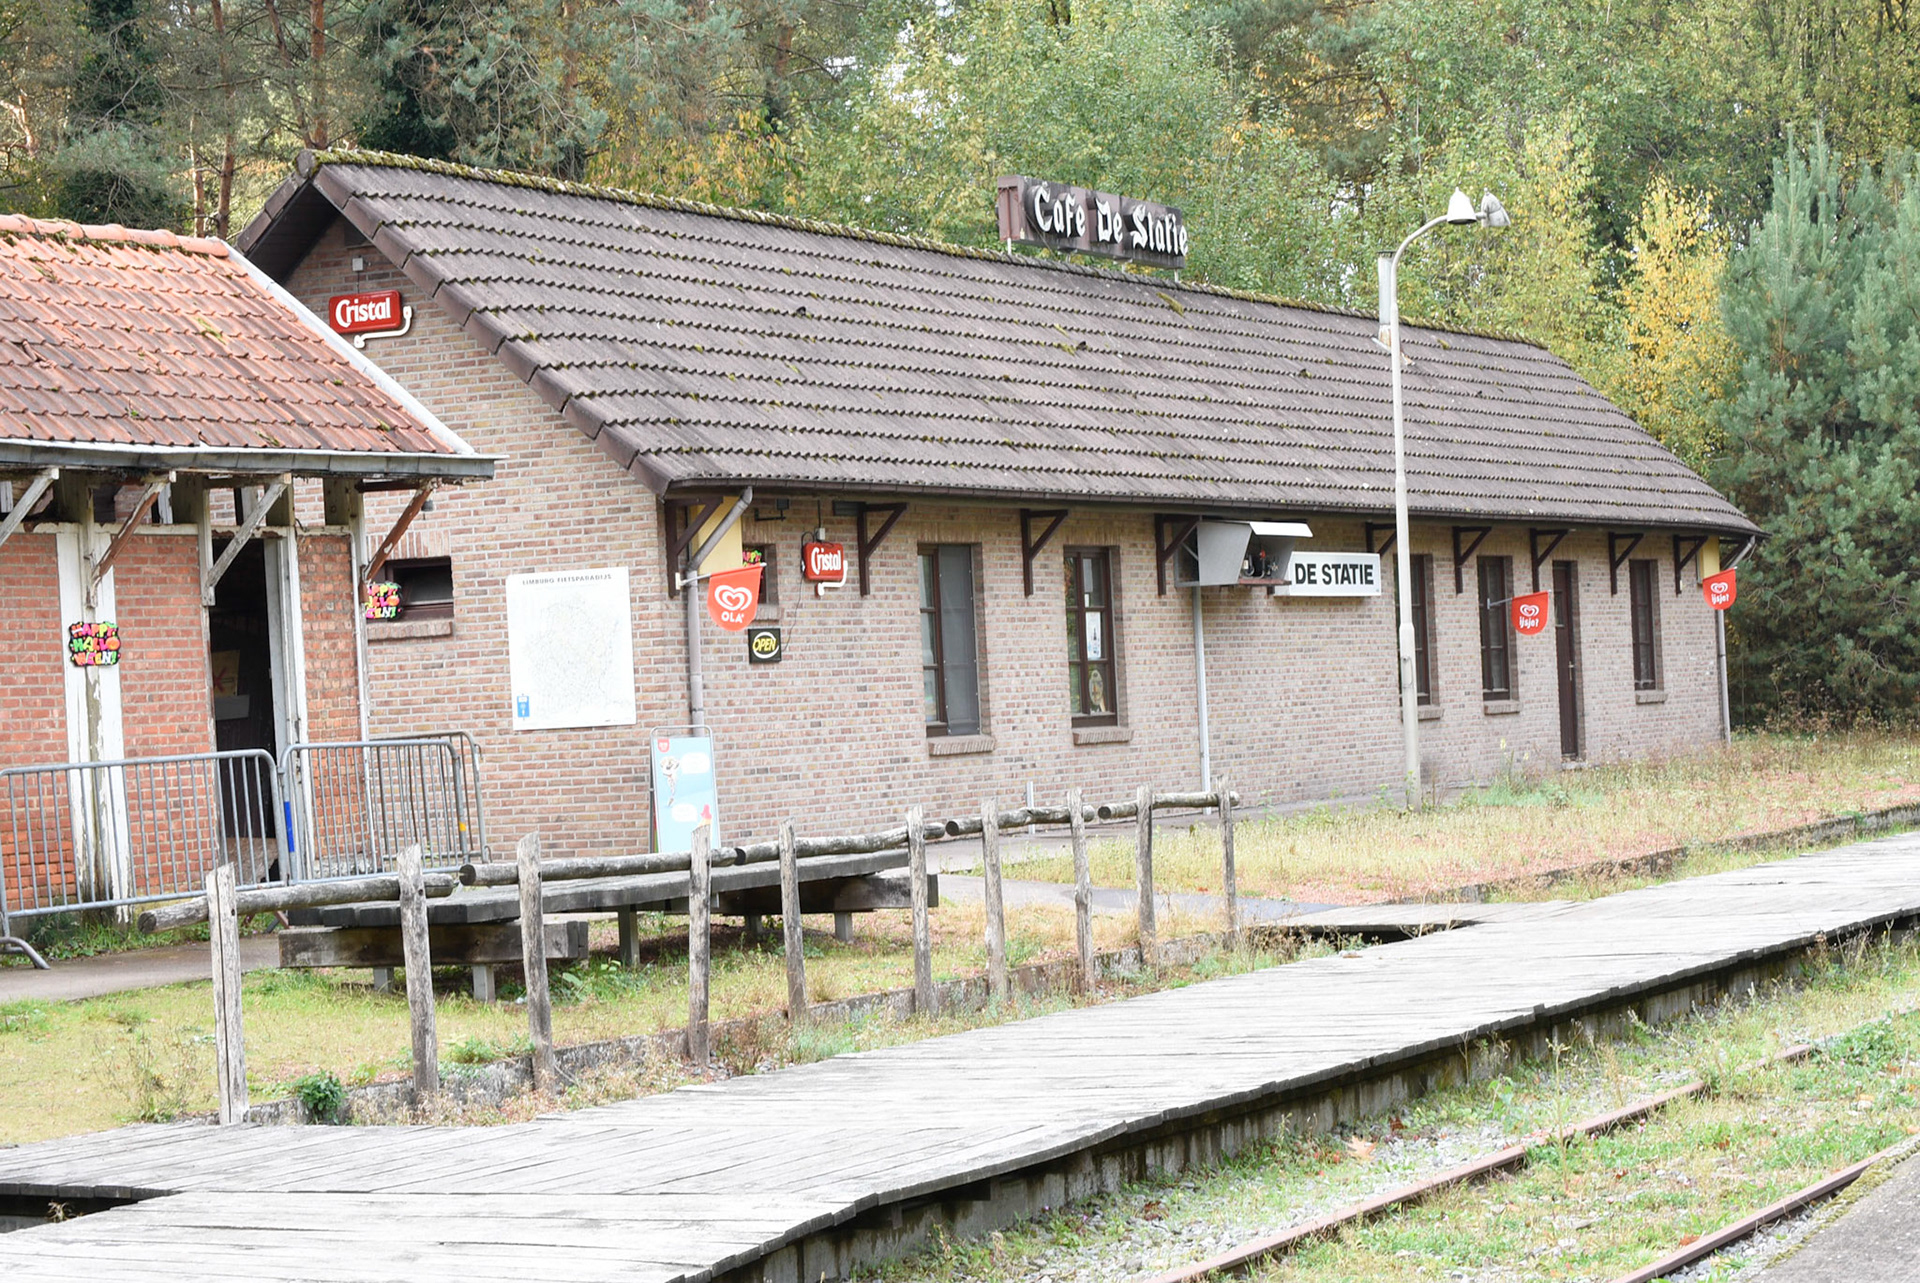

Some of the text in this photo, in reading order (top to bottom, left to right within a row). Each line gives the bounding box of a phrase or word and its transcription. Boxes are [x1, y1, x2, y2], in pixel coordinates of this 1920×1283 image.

[1095, 198, 1124, 244] De
[1130, 204, 1189, 256] Statie
[335, 297, 392, 328] Cristal
[811, 547, 842, 575] Cristal
[1294, 563, 1374, 585] DE STATIE
[721, 611, 743, 623] OLA
[752, 637, 776, 652] OPEN
